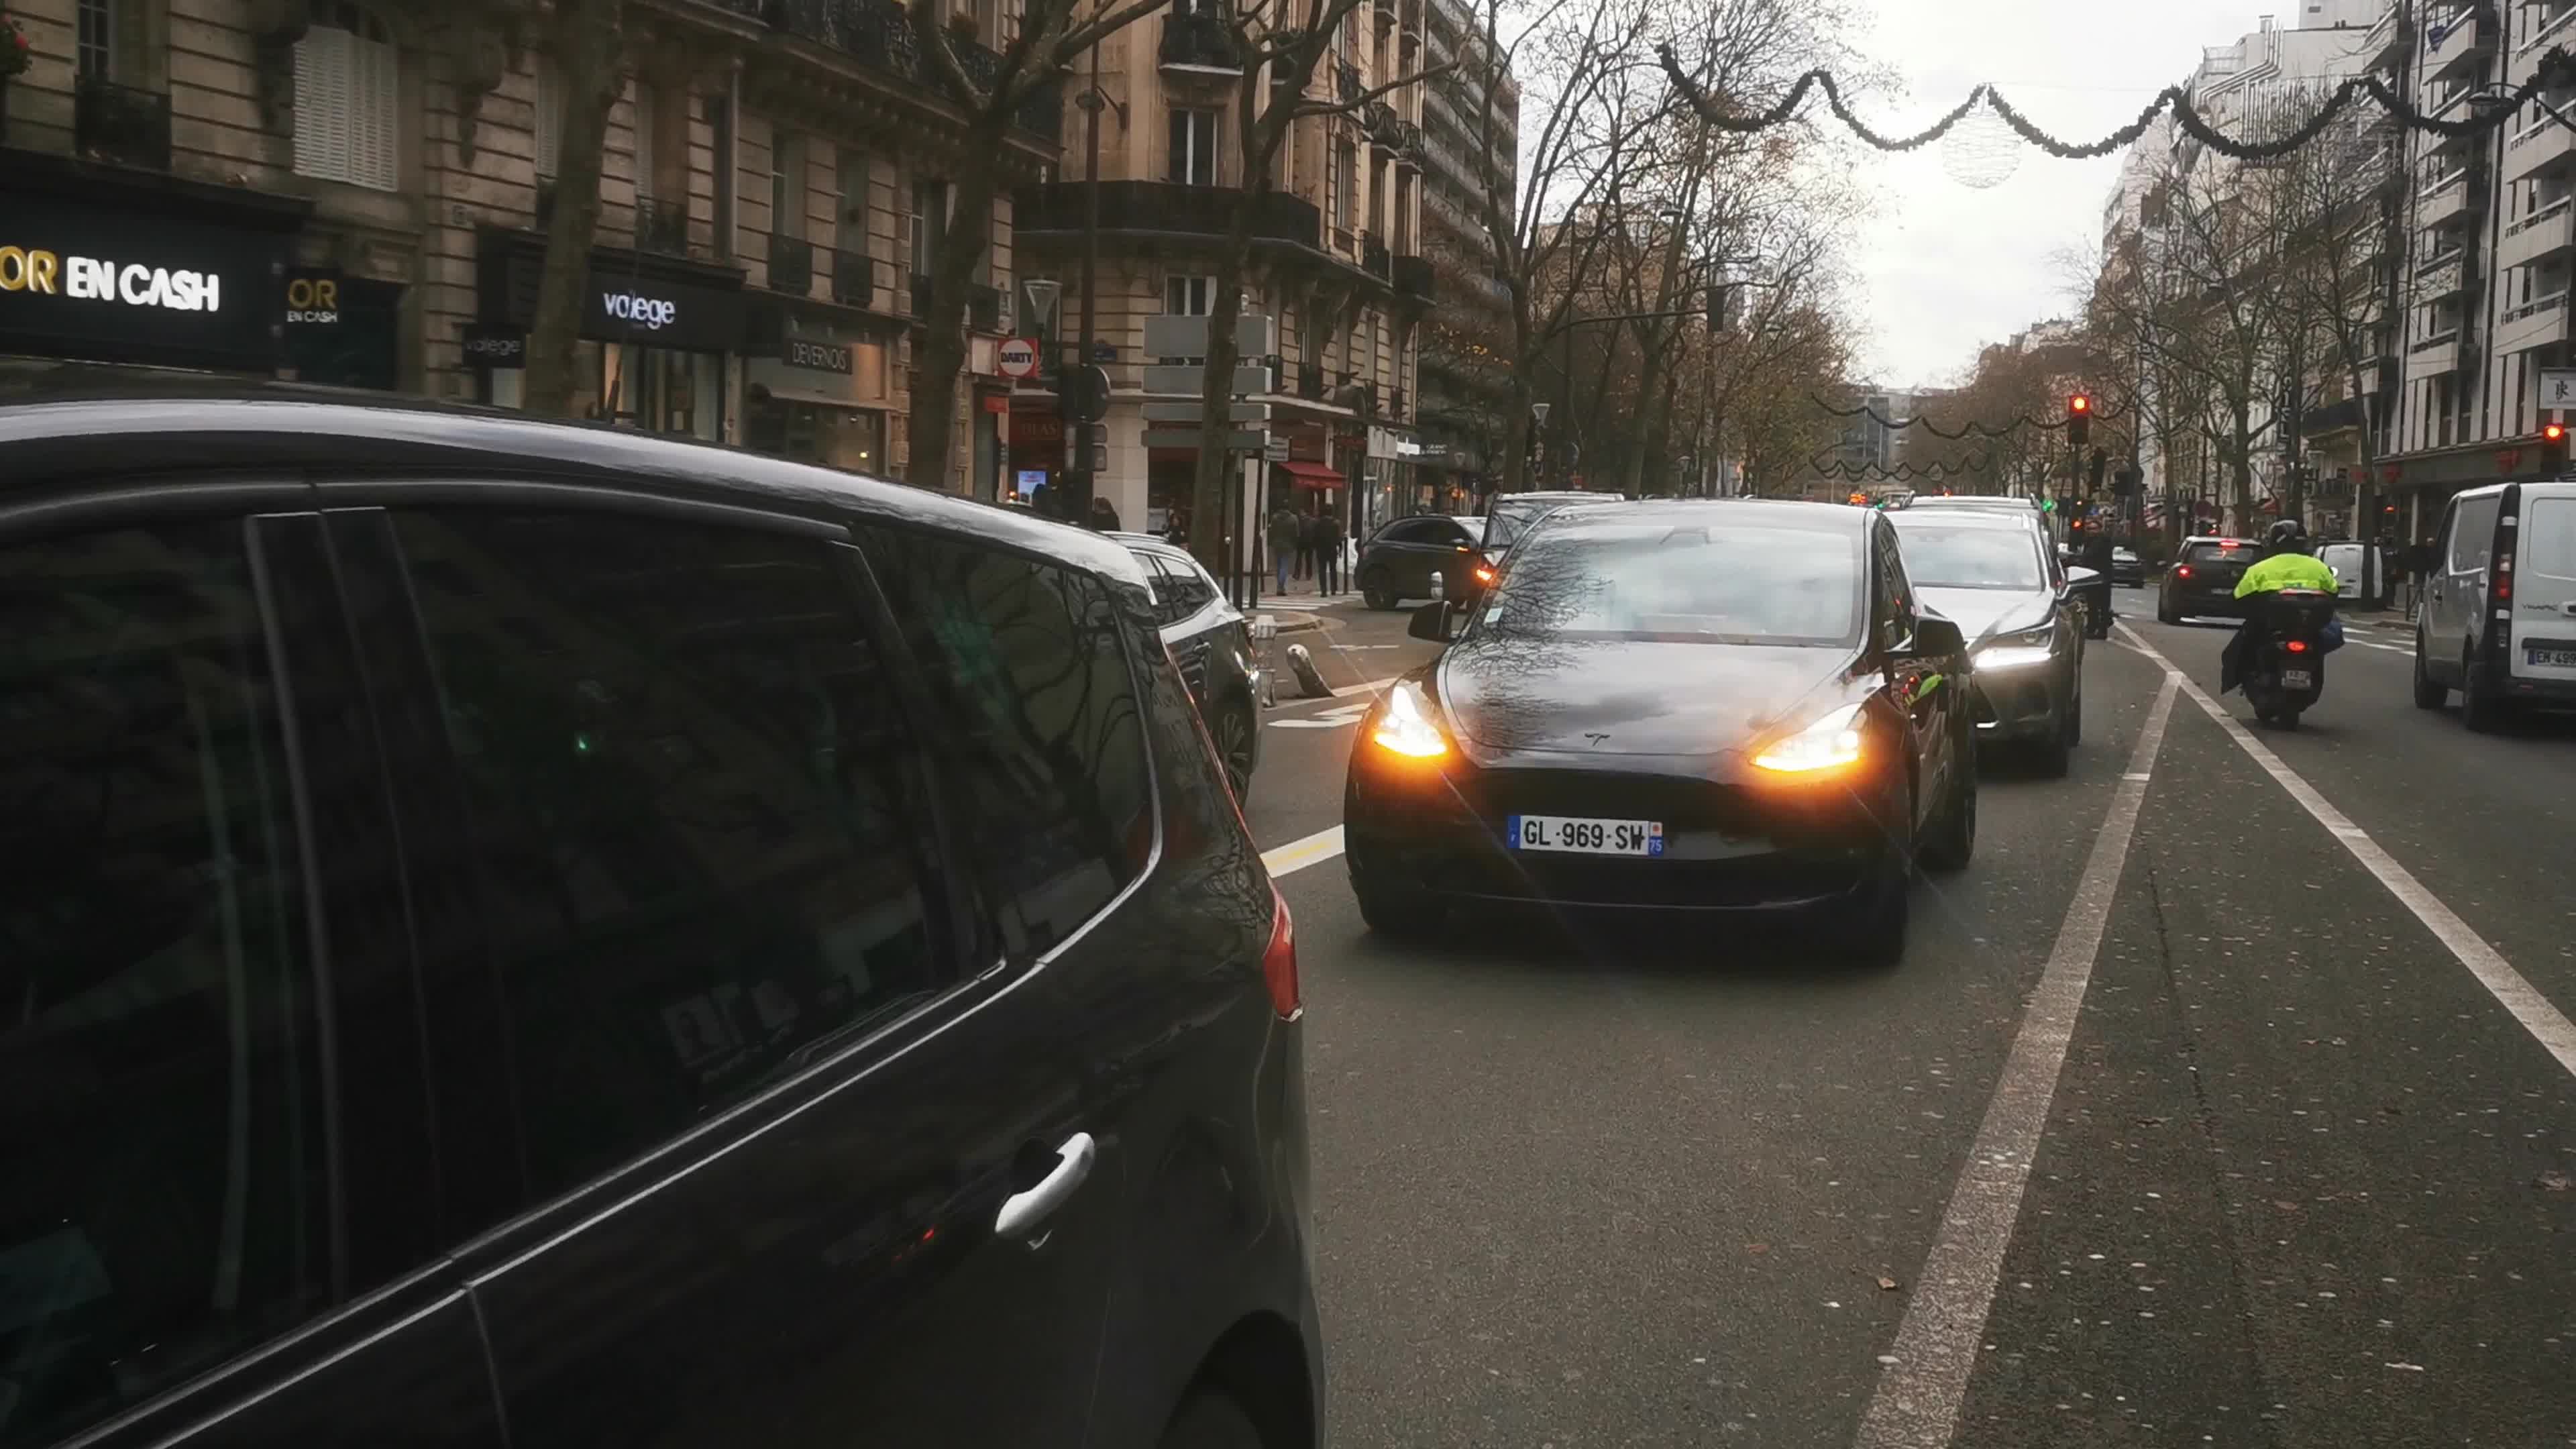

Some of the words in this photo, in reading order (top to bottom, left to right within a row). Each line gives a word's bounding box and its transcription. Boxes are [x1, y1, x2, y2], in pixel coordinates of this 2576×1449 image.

[0, 246, 58, 294] OR
[66, 256, 115, 301] EN
[119, 264, 219, 312] CASH
[288, 280, 337, 308] OR
[1001, 353, 1032, 363] DARTY
[1650, 840, 1662, 853] 75
